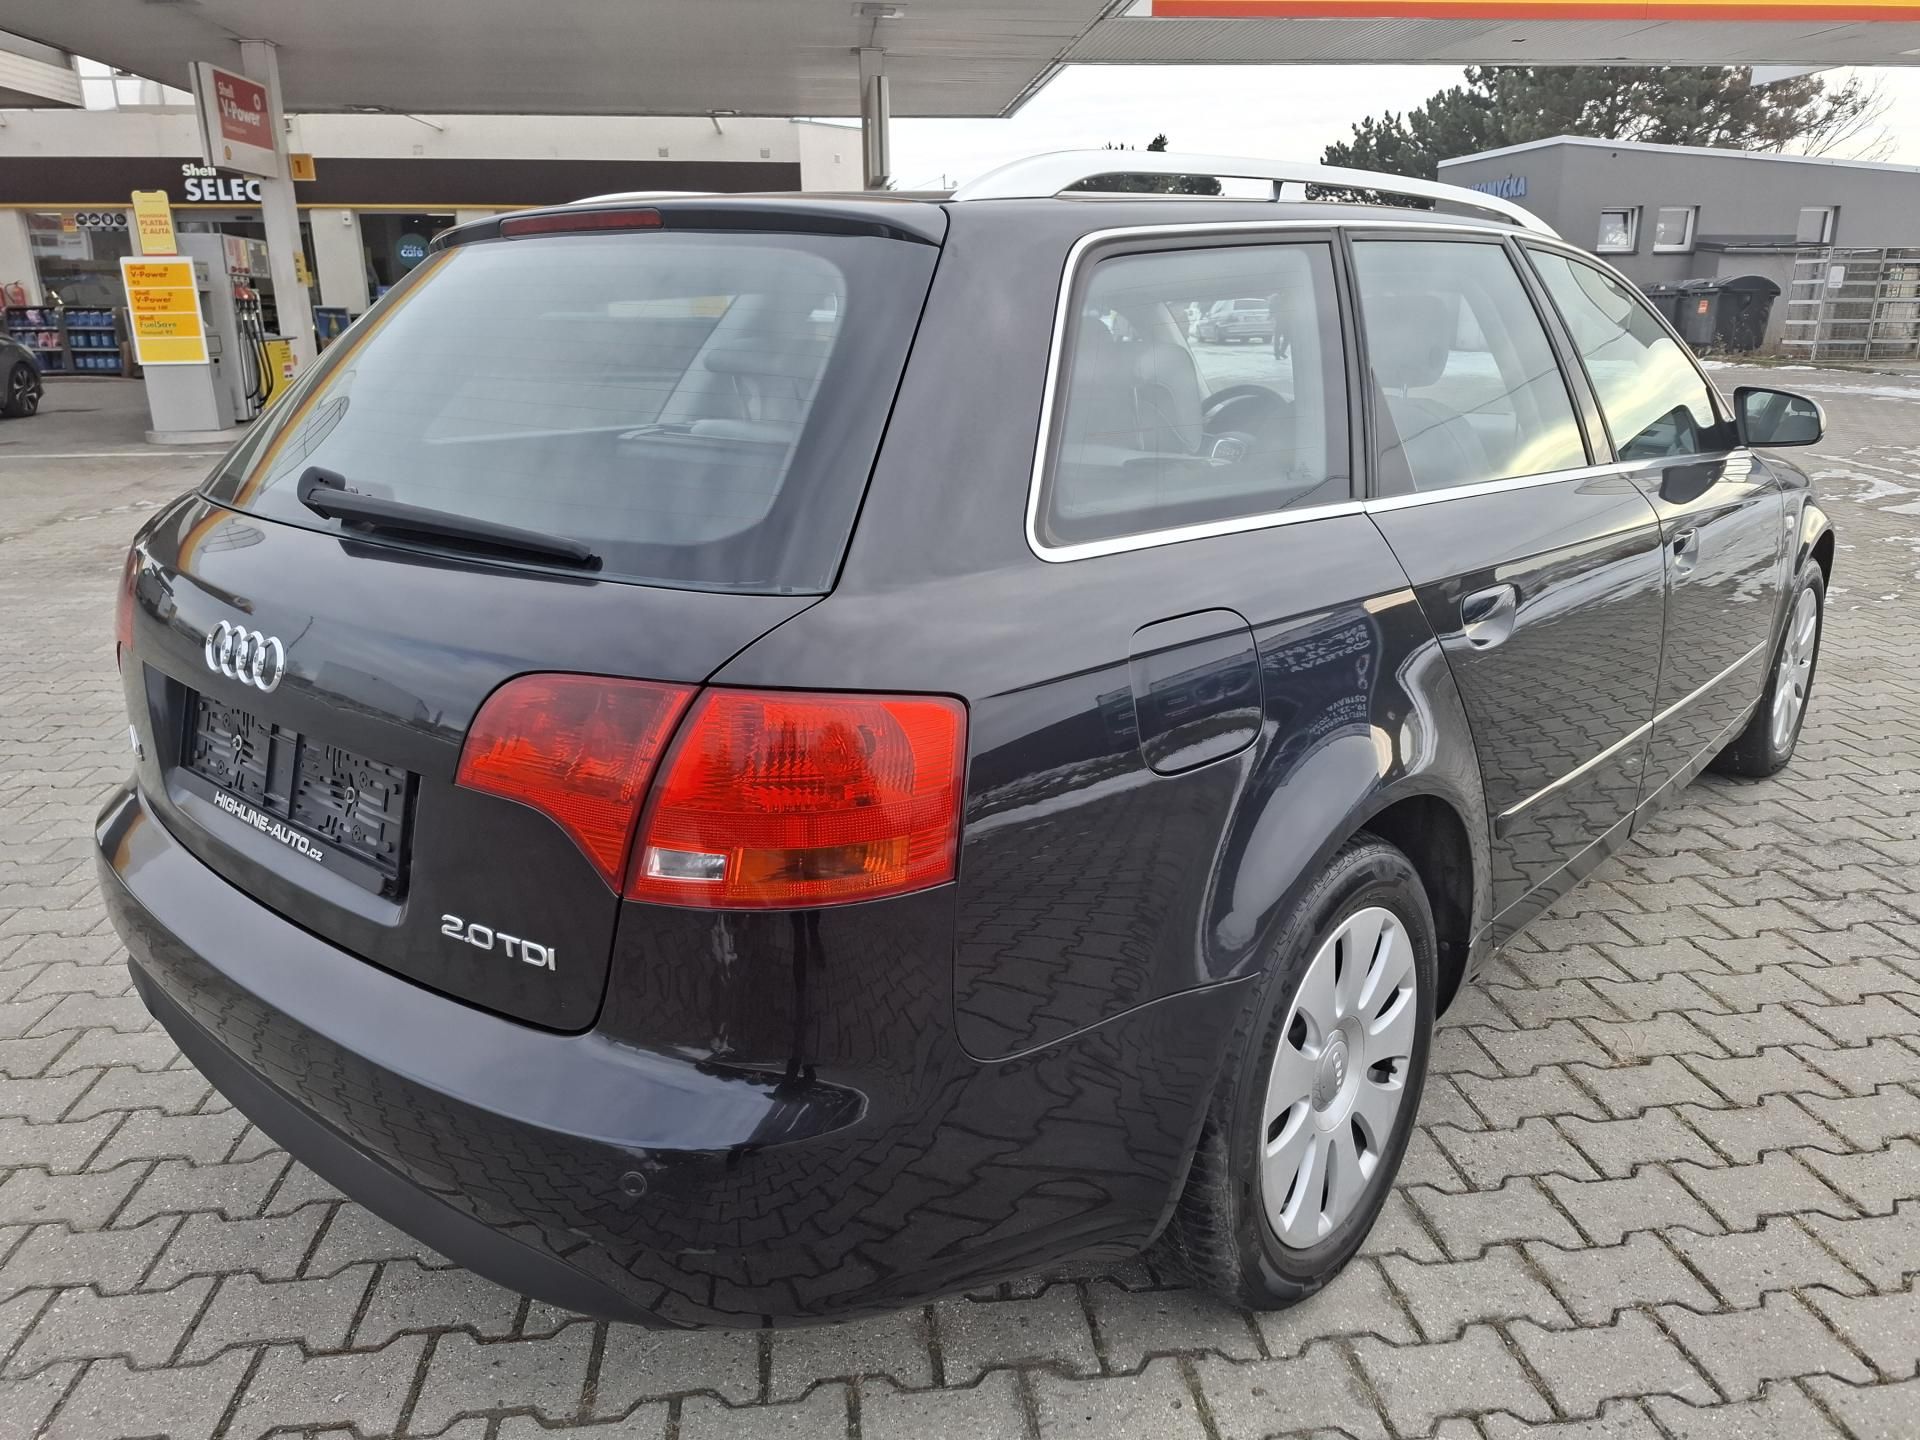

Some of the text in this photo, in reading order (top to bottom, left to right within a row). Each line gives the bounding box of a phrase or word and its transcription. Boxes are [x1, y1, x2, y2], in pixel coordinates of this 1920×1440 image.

[218, 82, 235, 99] Shell
[220, 97, 261, 127] V-Power
[182, 163, 217, 176] Shell
[294, 160, 303, 174] 1
[184, 178, 262, 202] SELEC
[135, 296, 172, 304] V-Power
[140, 321, 177, 329] FuelSave
[214, 791, 323, 861] HIGHLINE-AUTO.cz
[441, 914, 556, 971] 2.0 TDI
